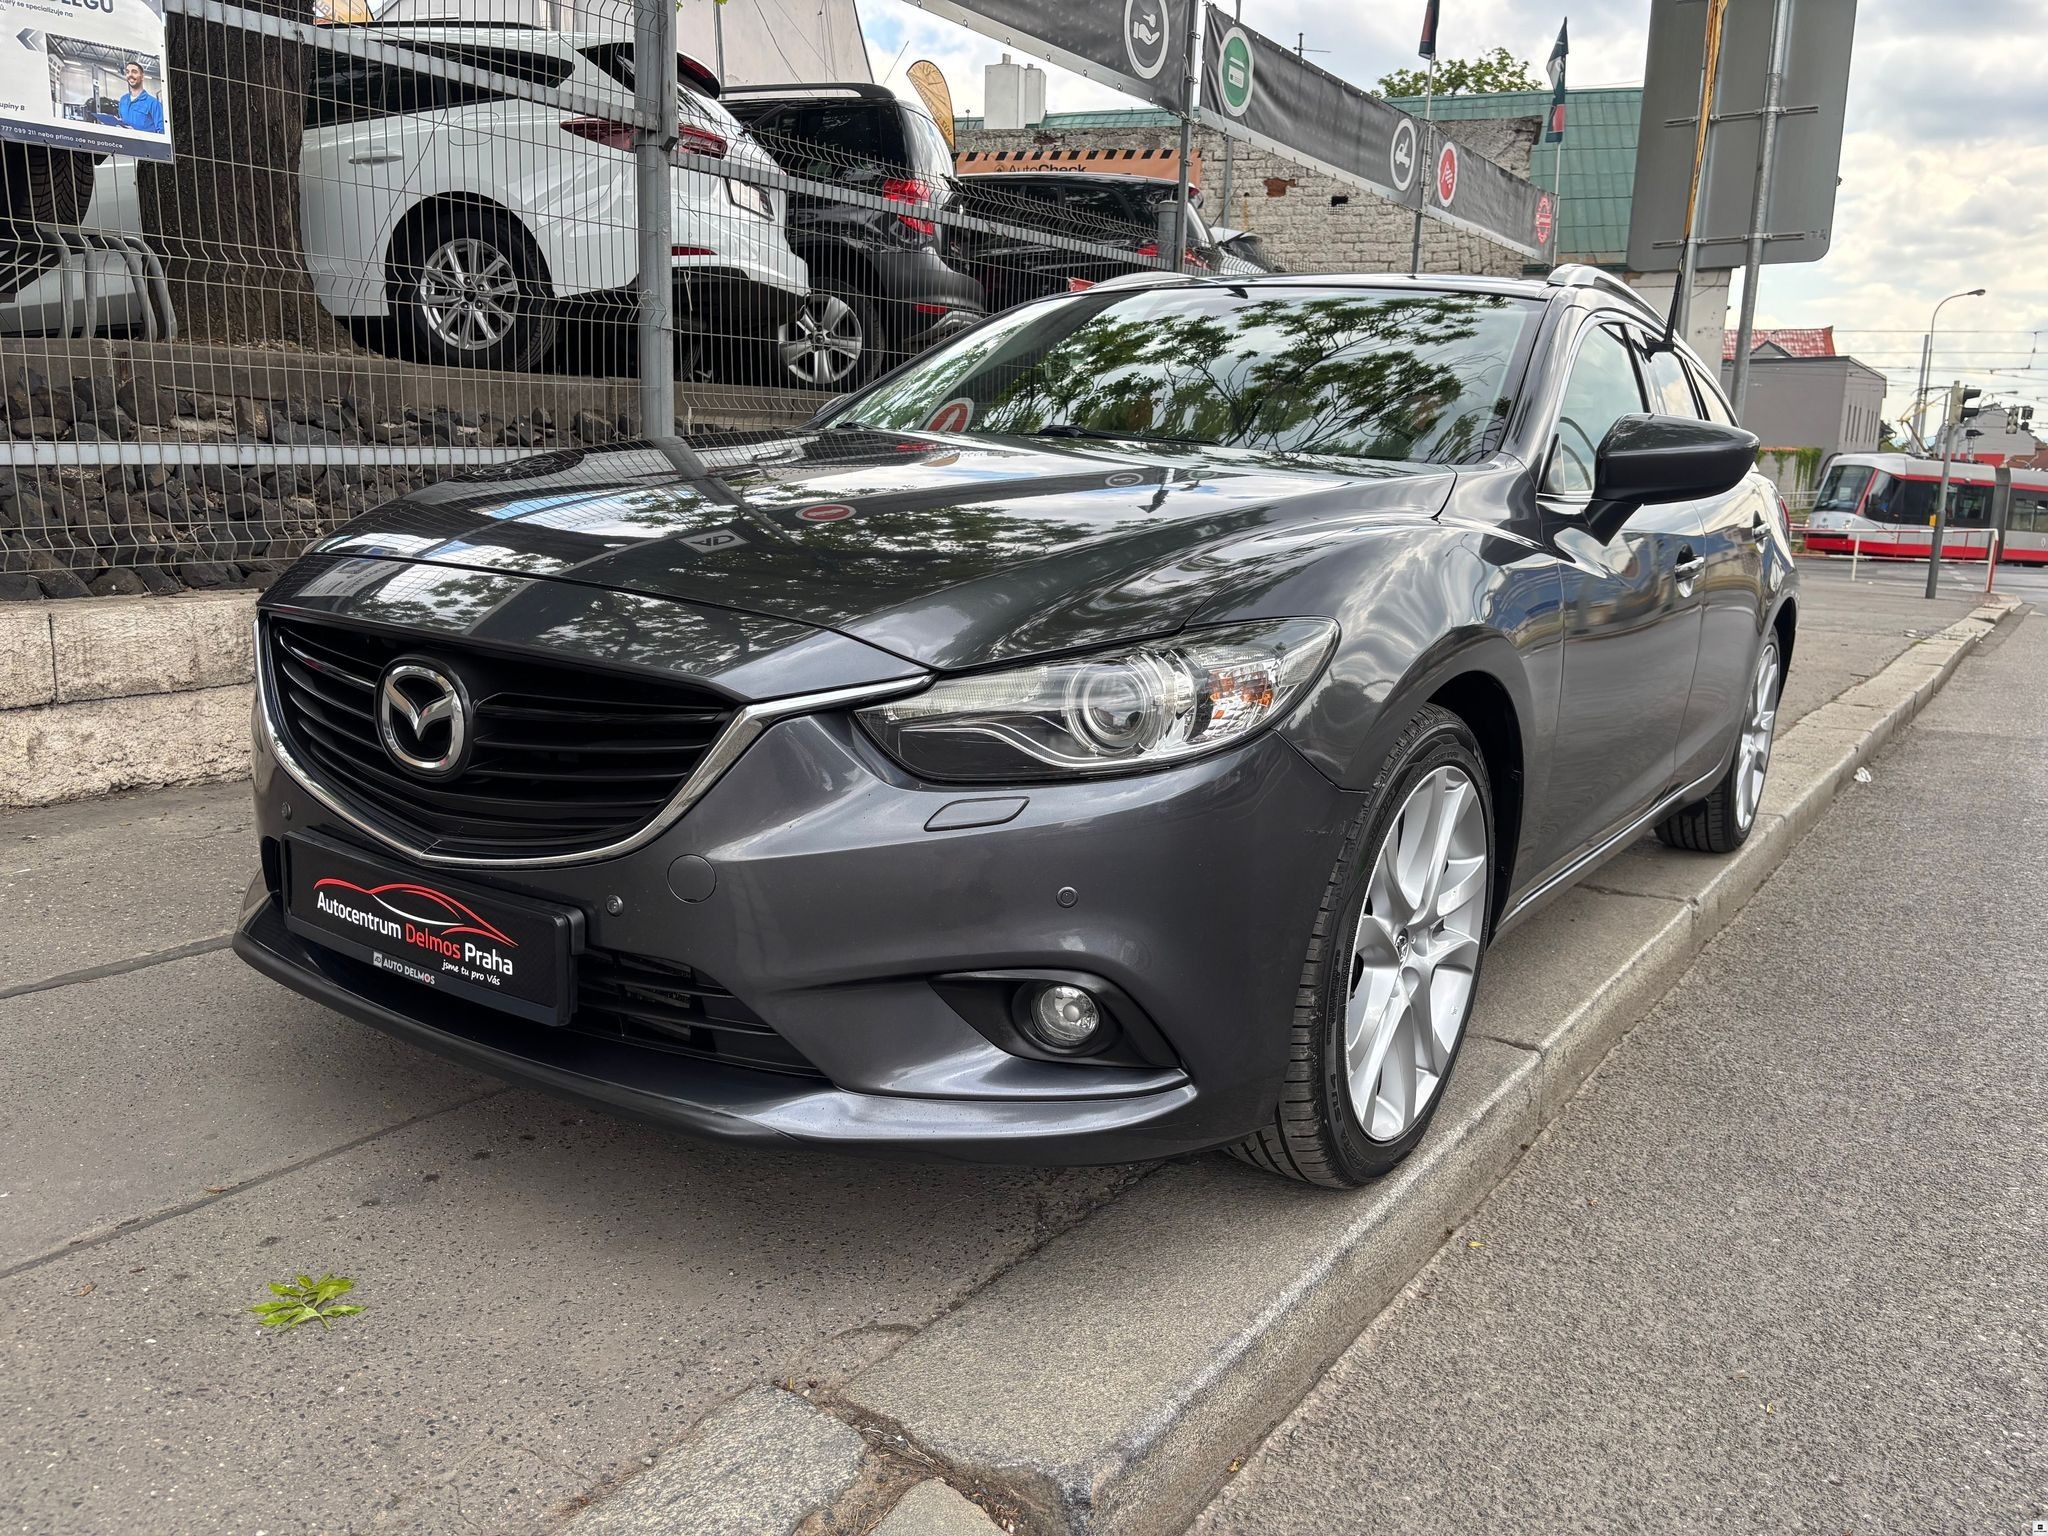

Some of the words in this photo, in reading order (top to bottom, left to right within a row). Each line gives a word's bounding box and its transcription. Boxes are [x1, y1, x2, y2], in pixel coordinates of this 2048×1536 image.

[26, 3, 63, 16] specializuje
[38, 131, 54, 139] nebo
[1009, 164, 1087, 172] AutoCheck
[317, 891, 401, 940] Autocentrum
[405, 923, 461, 960] Delmos
[464, 942, 514, 975] Praha
[383, 958, 403, 973] AUTO
[404, 965, 435, 985] DELMOS
[441, 959, 459, 973] jsme
[461, 966, 469, 976] tu
[470, 970, 485, 981] pro
[486, 973, 500, 986] Vás
